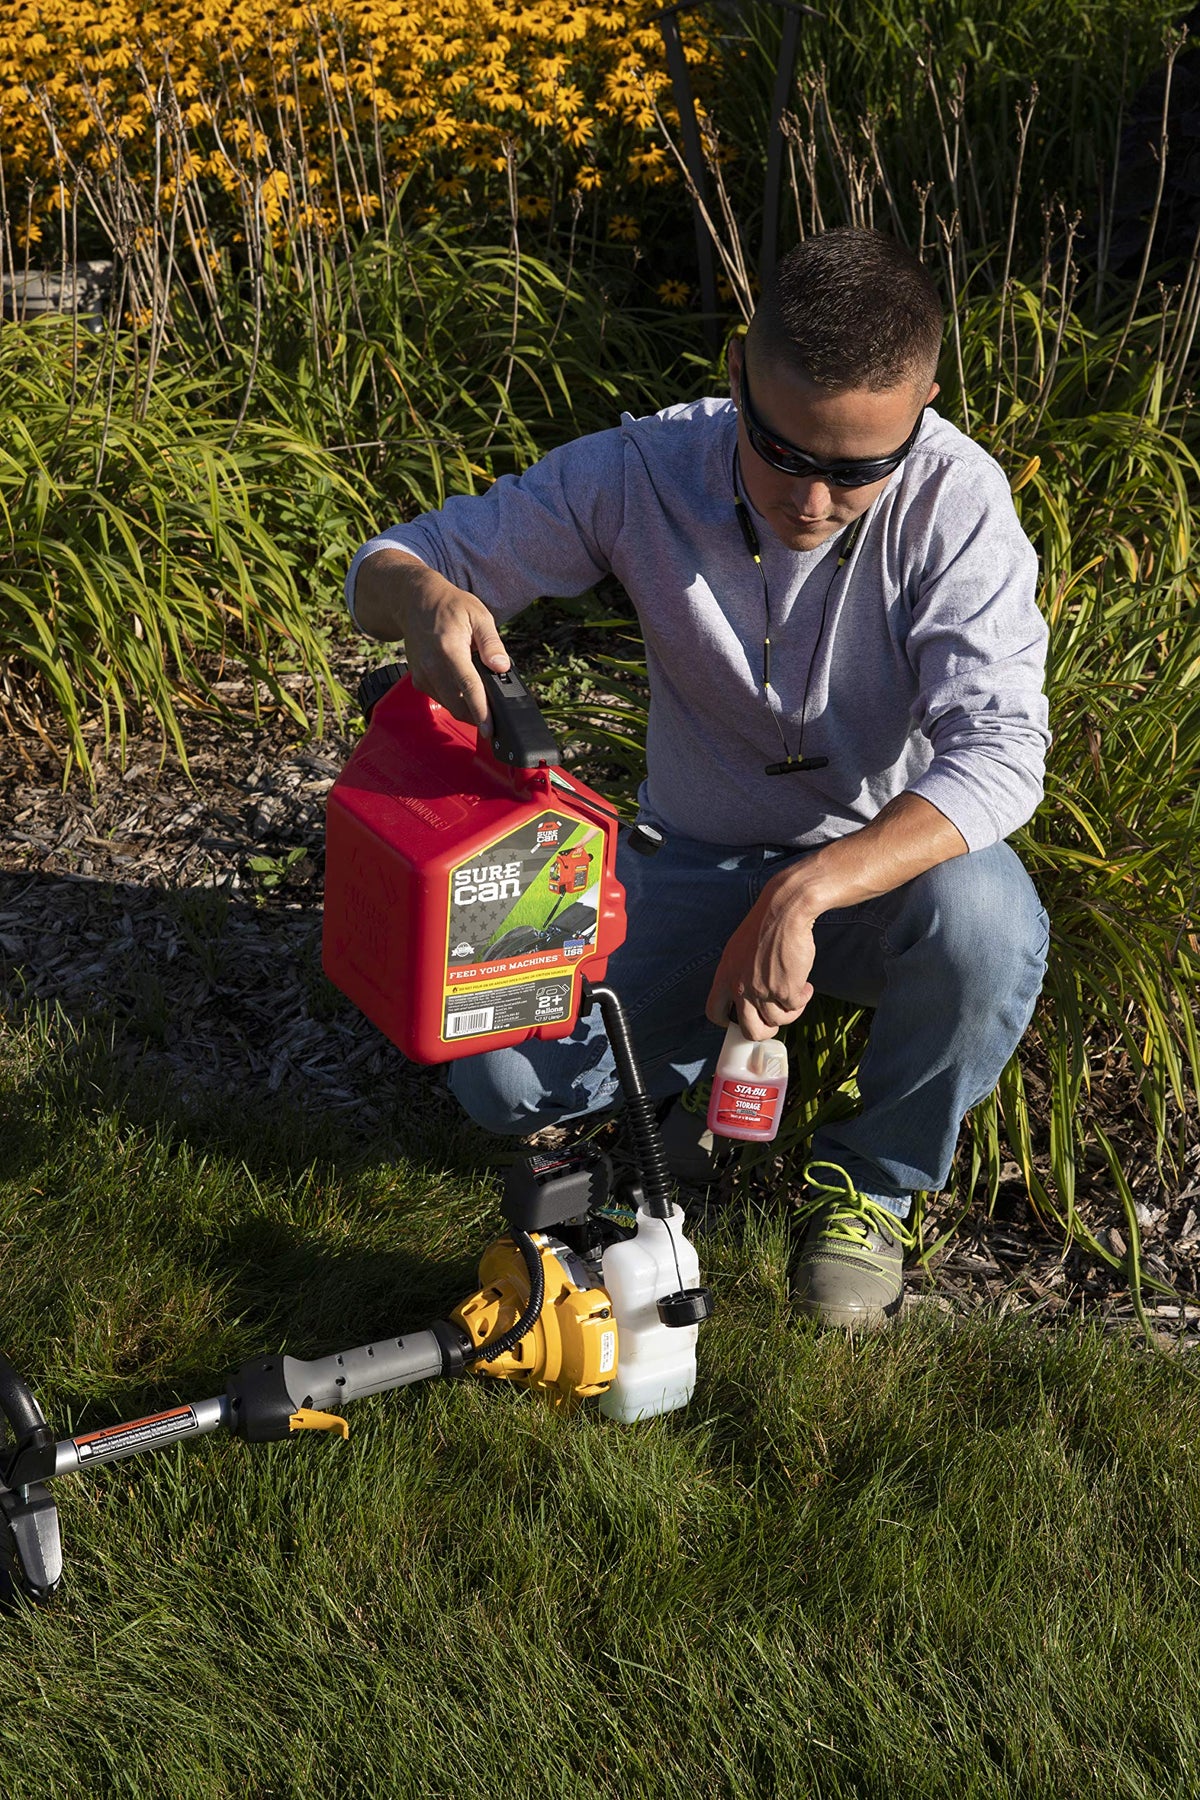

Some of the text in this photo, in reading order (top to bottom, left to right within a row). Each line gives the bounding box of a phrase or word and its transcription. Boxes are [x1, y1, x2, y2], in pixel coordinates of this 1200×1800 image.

[536, 830, 558, 838] SURE
[454, 862, 522, 886] SURE
[454, 880, 522, 906] can
[449, 956, 558, 980] FEED YOUR MACHINES
[538, 994, 563, 1009] 2+
[535, 1006, 564, 1016] Gallons
[736, 1101, 761, 1110] STORAGE
